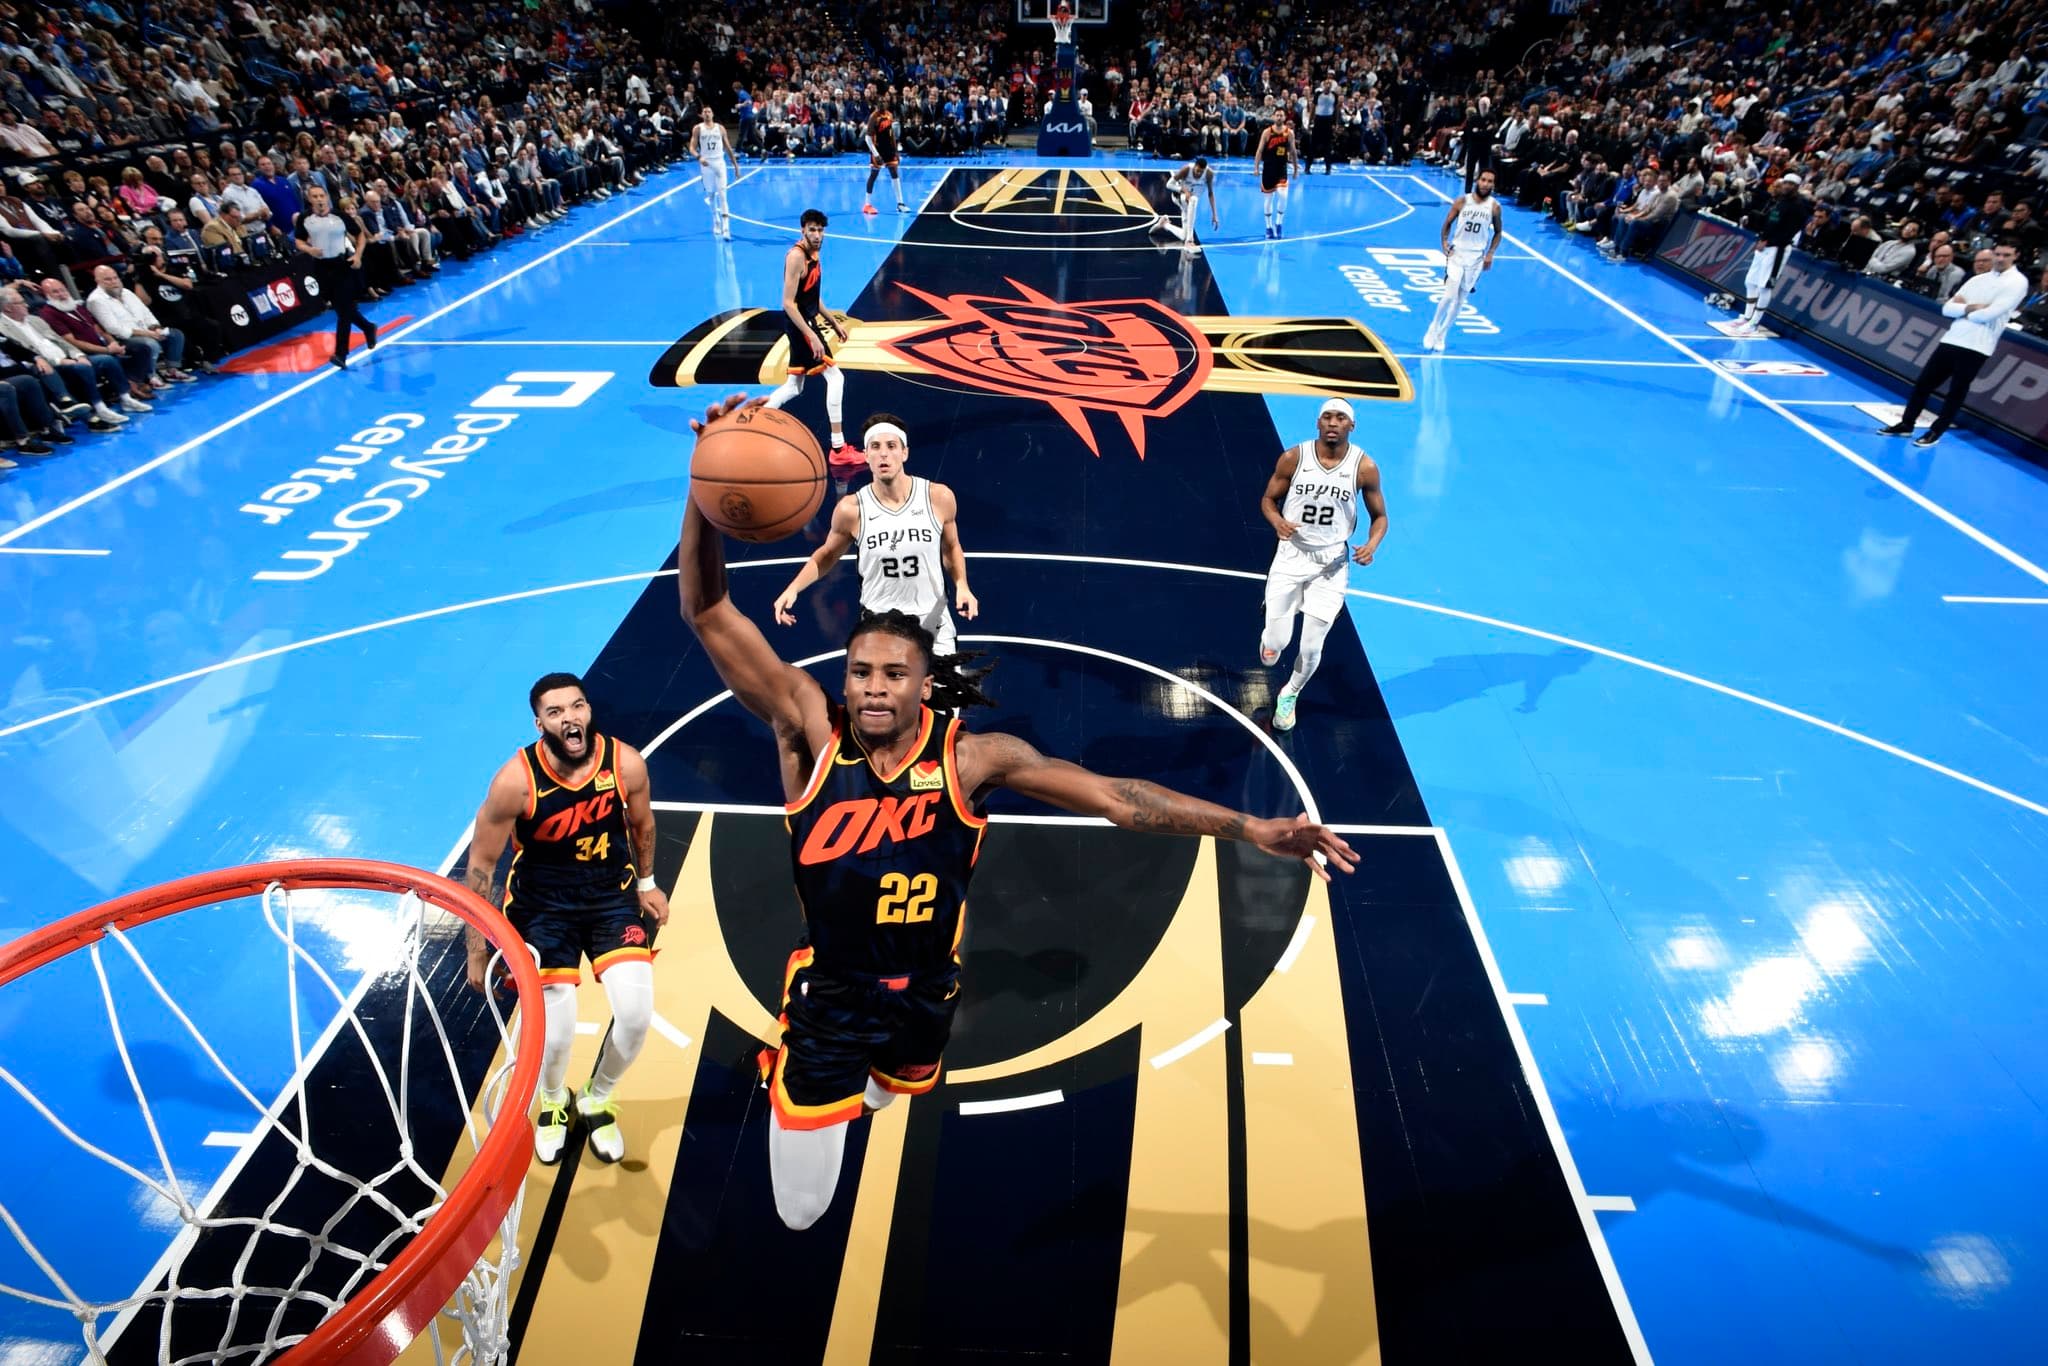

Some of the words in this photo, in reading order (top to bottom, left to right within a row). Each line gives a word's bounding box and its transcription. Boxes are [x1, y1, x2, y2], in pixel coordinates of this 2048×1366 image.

[706, 142, 717, 151] 17
[1464, 221, 1481, 234] 30
[278, 288, 295, 301] TNT
[1338, 264, 1411, 312] center
[239, 412, 425, 525] center
[252, 413, 520, 580] paycom
[1295, 484, 1351, 502] SPURS
[1301, 504, 1334, 526] 22
[866, 528, 932, 552] SPURS
[881, 556, 920, 578] 23
[533, 790, 615, 843] OKC
[799, 791, 942, 866] OKC
[575, 831, 611, 862] 34
[876, 872, 938, 925] 22
